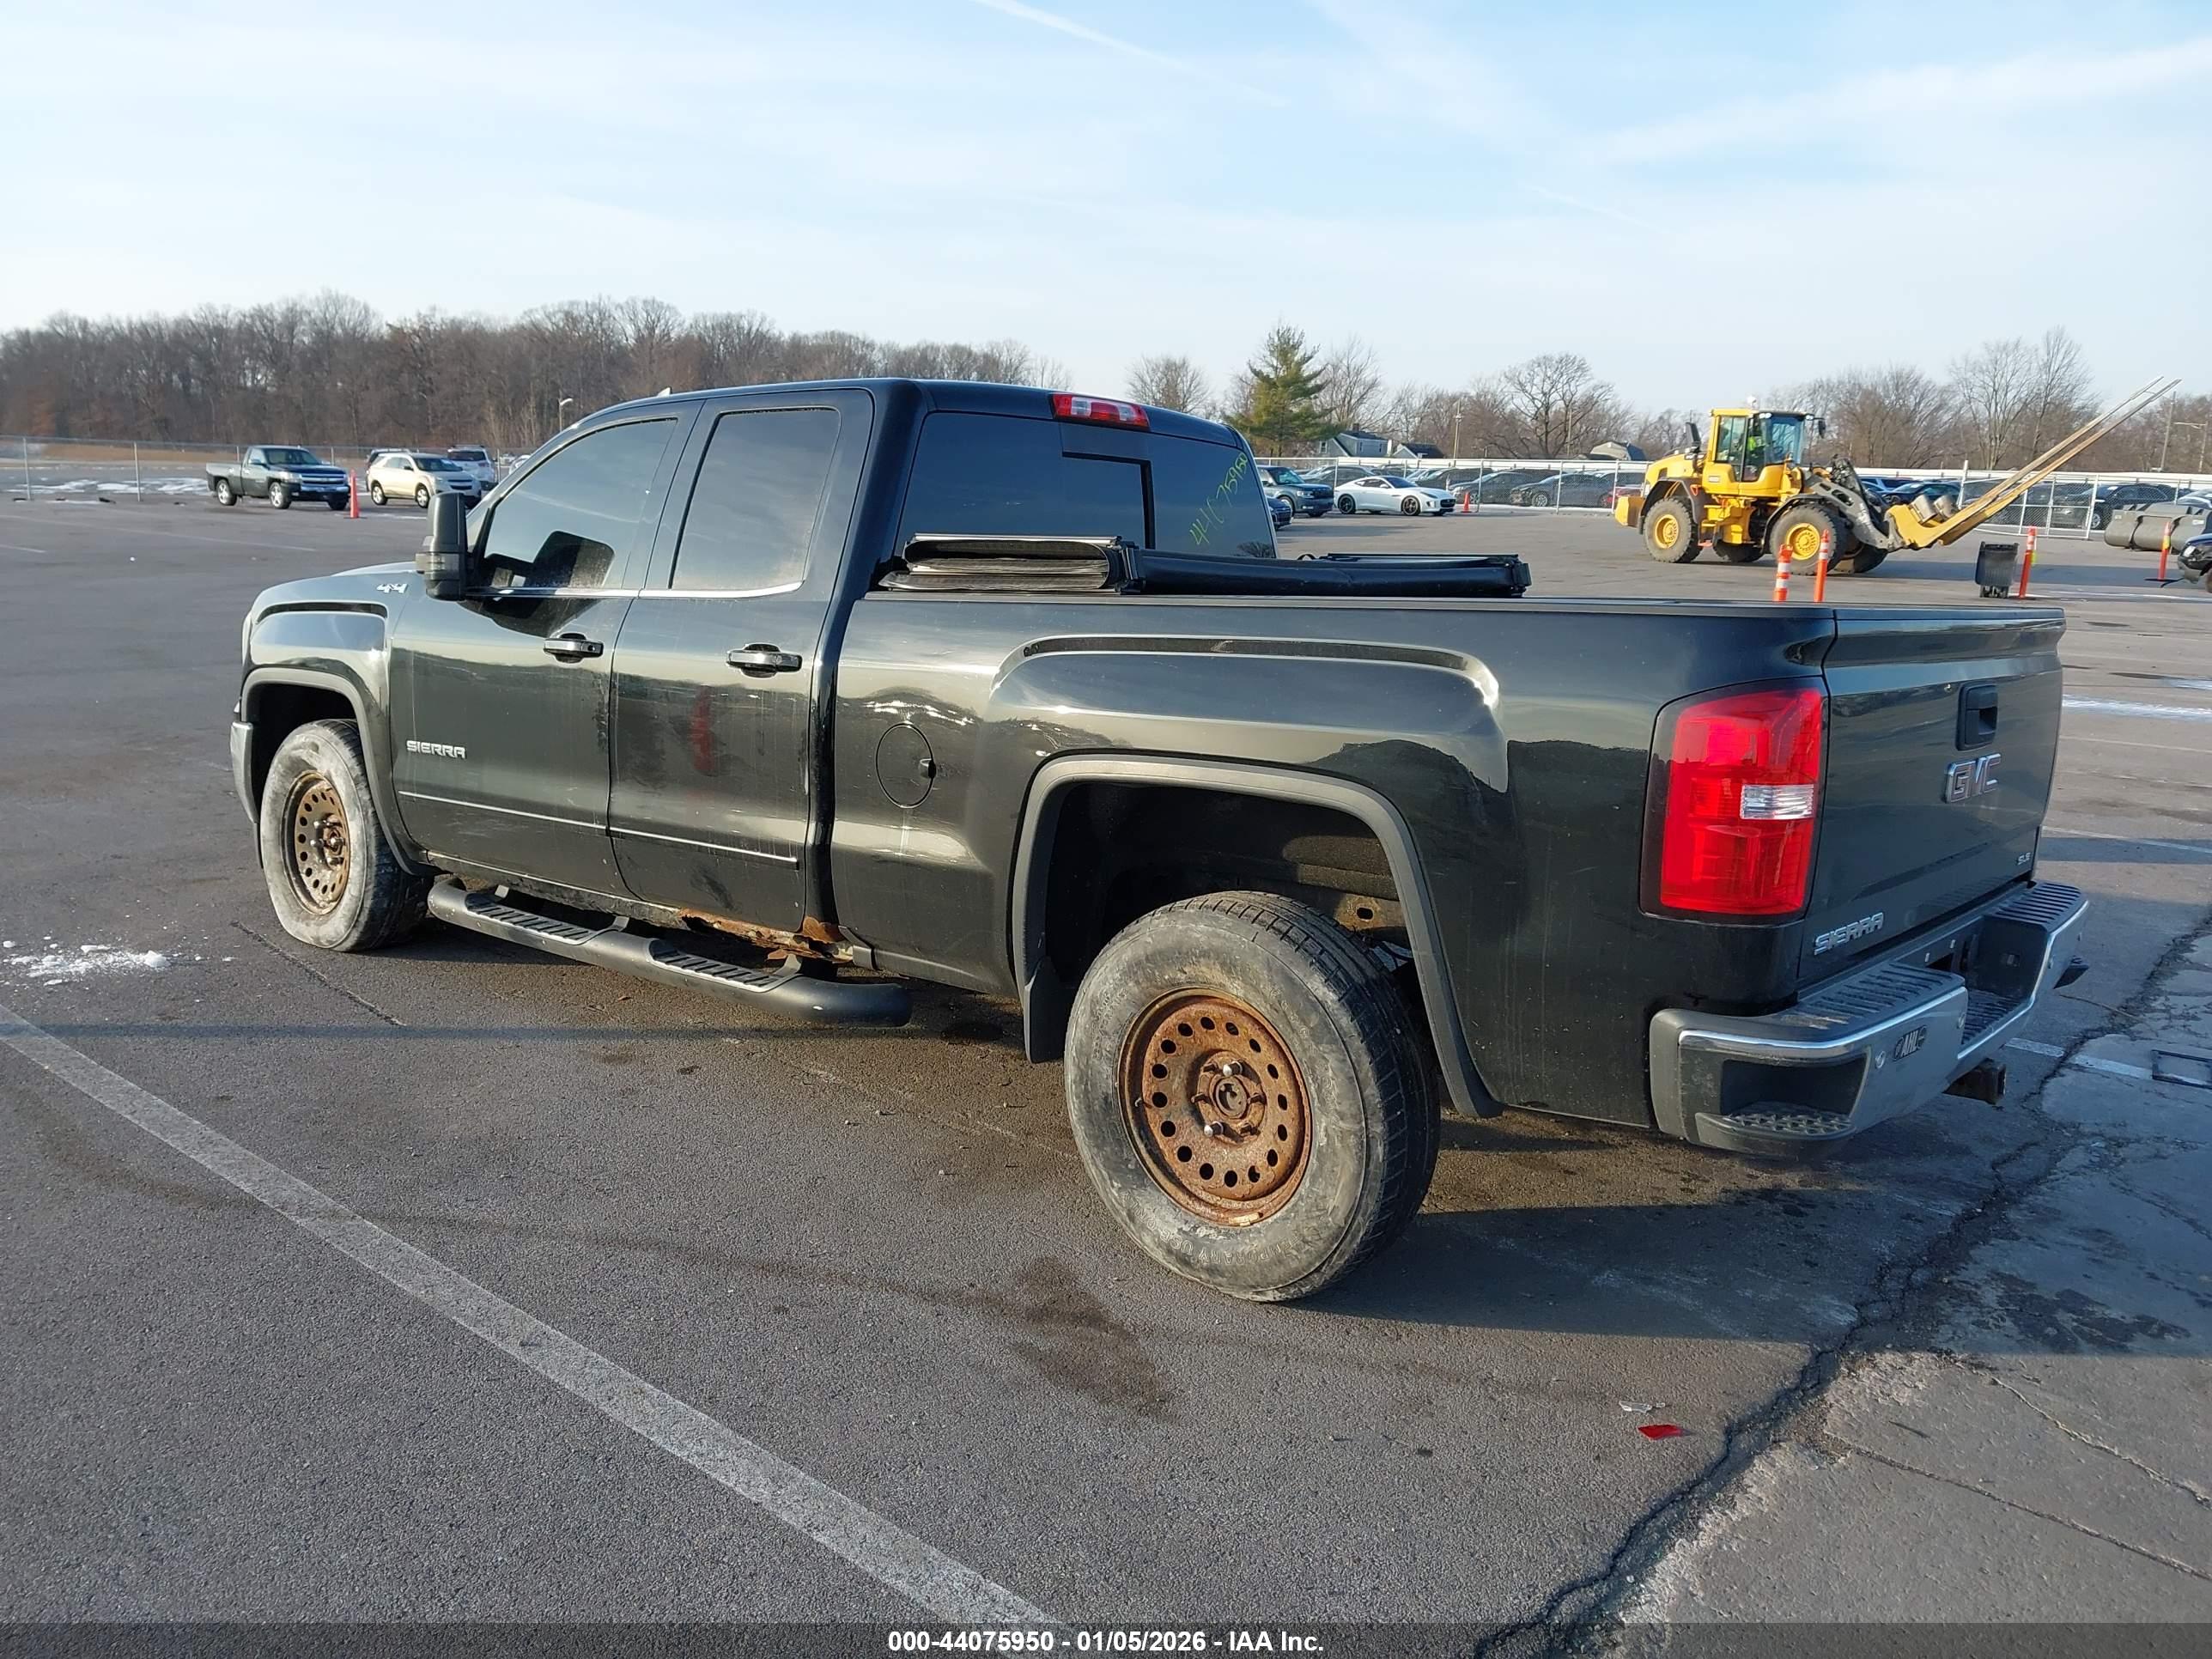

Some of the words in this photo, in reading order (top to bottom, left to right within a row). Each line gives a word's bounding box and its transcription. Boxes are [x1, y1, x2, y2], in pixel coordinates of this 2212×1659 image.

[406, 739, 466, 760] SIERRA
[1945, 753, 2002, 803] GMC
[1814, 912, 1884, 955] SIERRA
[1159, 1229, 1195, 1256] USE
